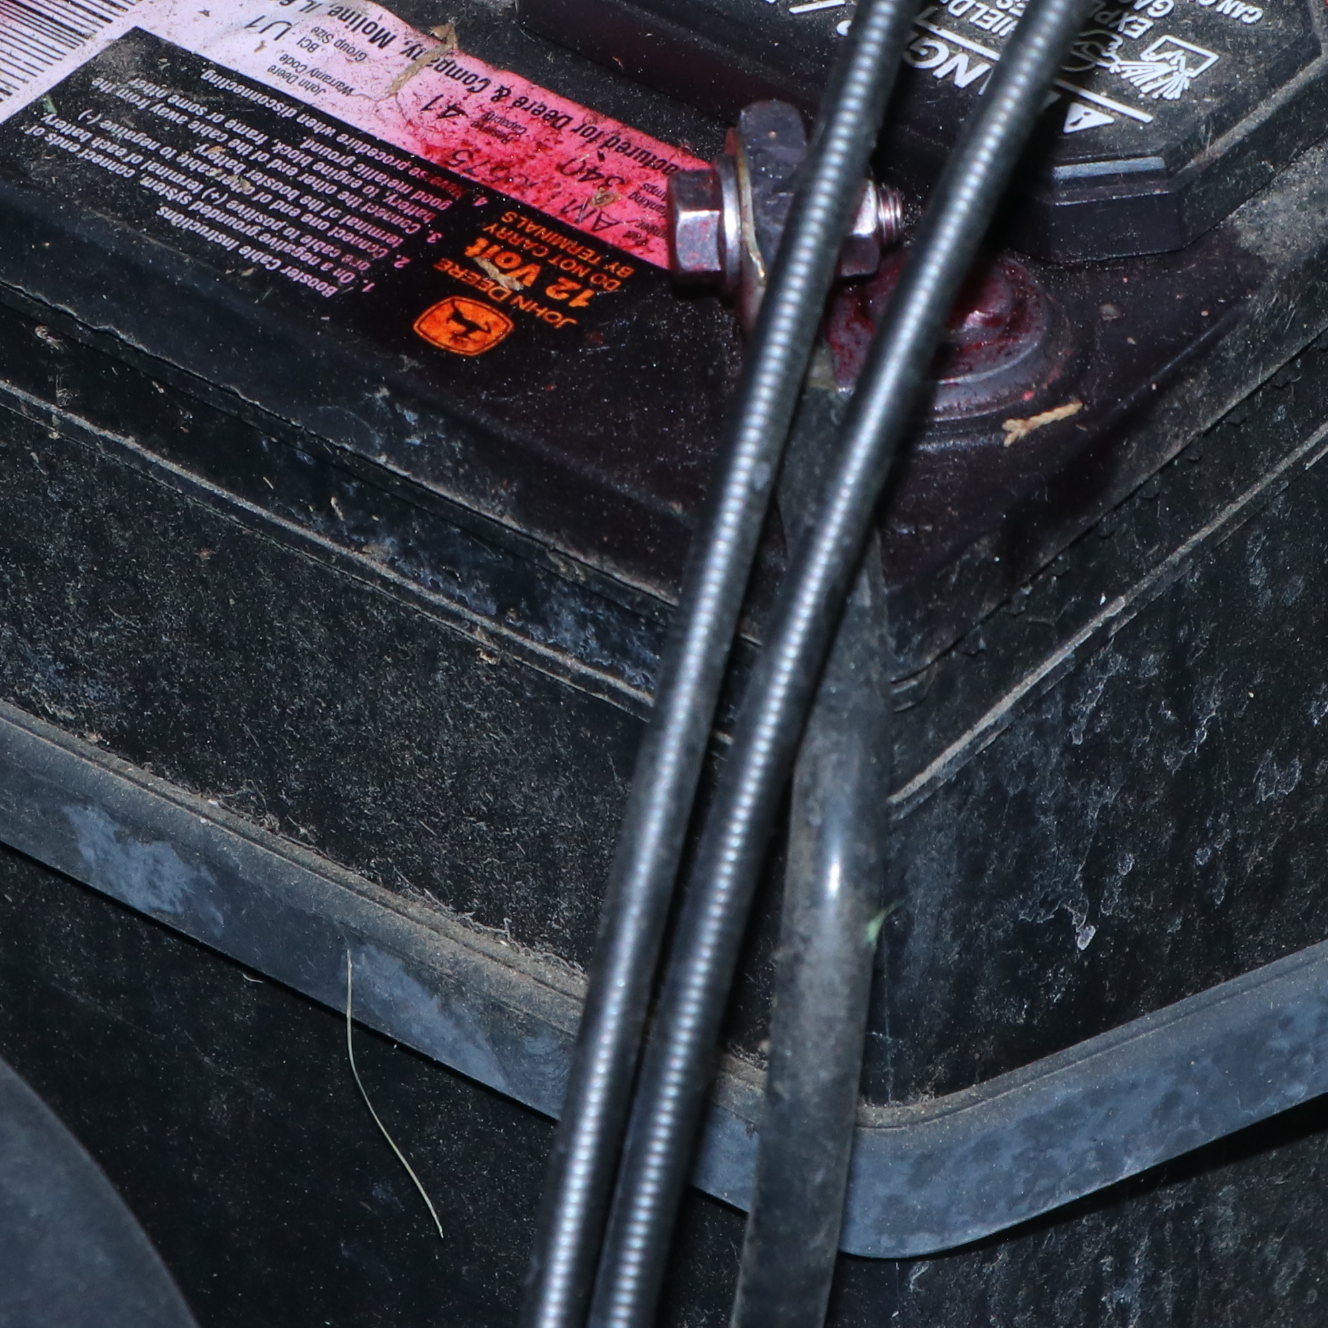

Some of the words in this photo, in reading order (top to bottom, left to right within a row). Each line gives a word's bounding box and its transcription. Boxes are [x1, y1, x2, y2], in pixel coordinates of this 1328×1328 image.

[242, 12, 295, 41] U1
[304, 25, 337, 44] Size
[318, 1, 396, 49] Moline,
[293, 35, 322, 53] BCI
[328, 37, 373, 62] Group
[264, 63, 301, 84] Deere
[275, 52, 311, 73] Code
[87, 75, 118, 94] the
[125, 74, 170, 100] other
[193, 64, 299, 122] disconnecting.
[294, 78, 327, 98] John
[303, 66, 359, 96] Warranty
[111, 86, 152, 110] from
[166, 91, 210, 116] some
[486, 85, 514, 104] &
[147, 100, 191, 126] away
[507, 94, 574, 131] Deere
[23, 123, 47, 139] of
[96, 116, 163, 153] negative
[183, 118, 230, 145] cable
[220, 117, 270, 145] frame
[292, 112, 338, 140] when
[566, 121, 605, 144] for
[40, 131, 82, 155] ends
[86, 135, 129, 159] each
[222, 137, 255, 157] the
[332, 129, 413, 174] procedure
[76, 147, 137, 180] connect
[138, 158, 206, 195] terminal
[265, 157, 301, 179] end
[309, 158, 366, 190] engine
[239, 167, 302, 201] booster
[294, 171, 339, 197] other
[348, 161, 414, 197] metallic
[267, 198, 303, 219] end
[295, 193, 327, 213] the
[332, 189, 364, 209] the
[409, 186, 455, 213] good
[186, 197, 264, 239] grounded
[221, 196, 288, 232] positive
[298, 211, 332, 231] one
[151, 204, 241, 251] Instructions
[337, 212, 405, 249] terminal
[419, 228, 444, 244] 3.
[480, 220, 554, 258] CARRY
[497, 209, 607, 265] TERMINALS
[254, 229, 326, 268] negative
[296, 233, 343, 259] cable
[325, 224, 390, 260] Connect
[233, 243, 284, 271] Cable
[385, 253, 412, 269] 2.
[457, 235, 552, 287] Volt
[545, 251, 593, 278] NOT
[602, 258, 636, 279] BY
[276, 263, 341, 298] Booster
[353, 278, 379, 294] 1.
[540, 275, 601, 311] 12
[586, 270, 623, 292] DO
